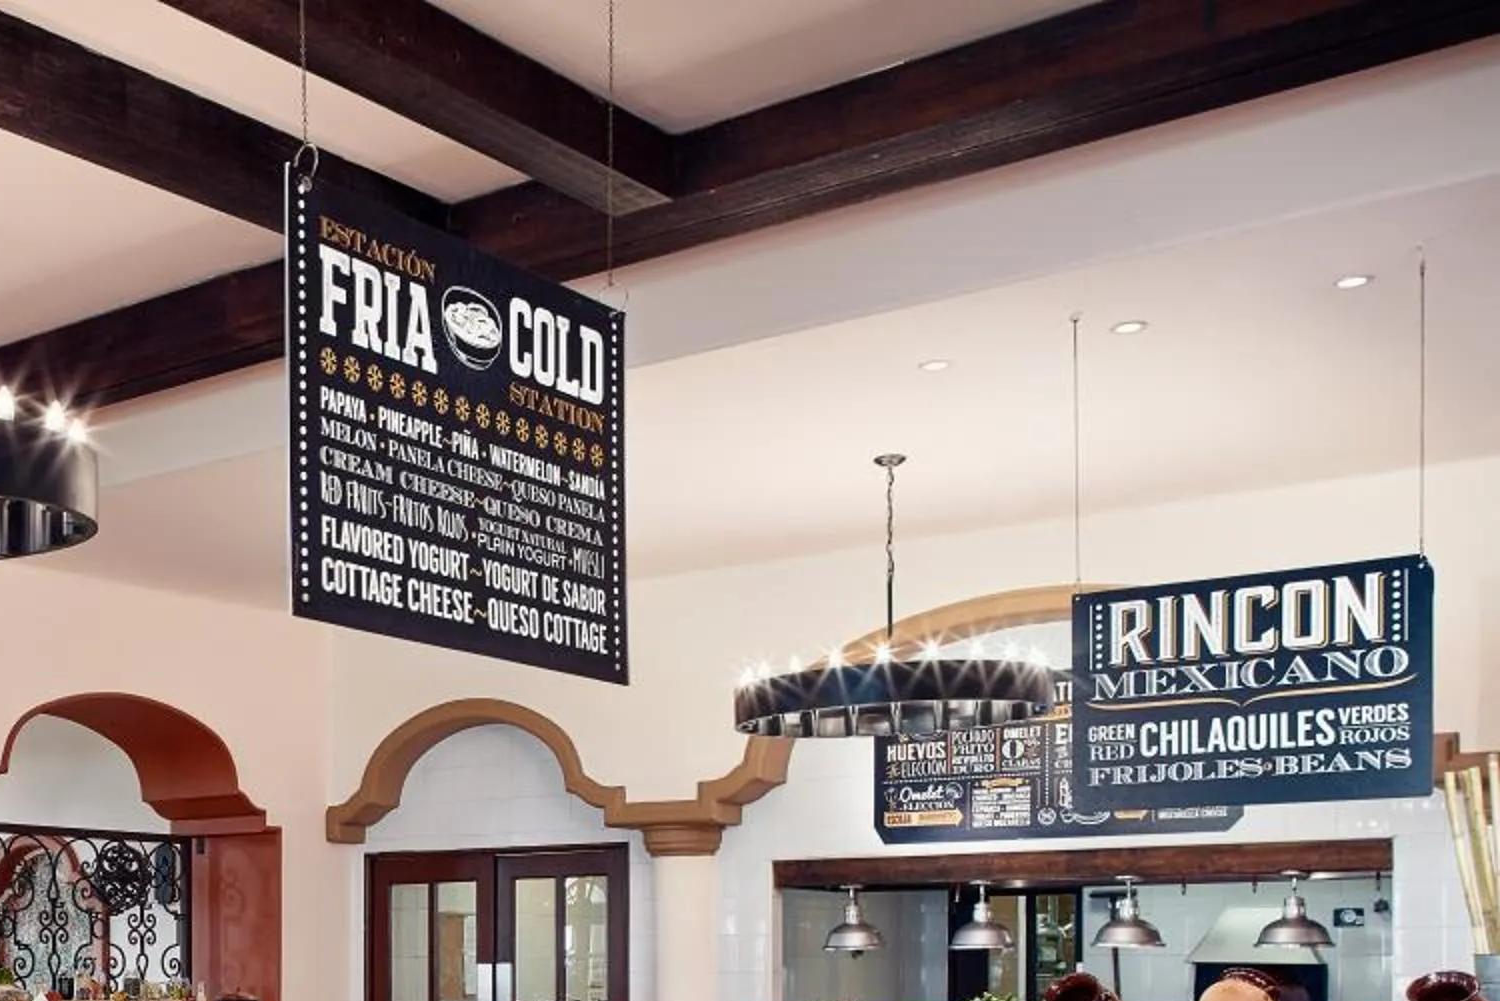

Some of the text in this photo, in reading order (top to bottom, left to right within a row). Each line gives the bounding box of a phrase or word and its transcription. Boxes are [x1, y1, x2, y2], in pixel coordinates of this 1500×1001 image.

[318, 214, 436, 285] ESTACIÓN
[318, 243, 605, 406] FRIA COLD
[320, 385, 367, 423] PAPAYA
[378, 406, 443, 449] PINEAPPLE
[452, 429, 479, 461] PIÑA
[489, 443, 561, 486] WATERMELON
[507, 382, 605, 433] STATION
[320, 415, 605, 522] MELON PANELA CHEESE QUESO PANELA
[320, 446, 604, 546] CREAM CHEESE QUESO CREMA
[477, 533, 515, 557] PLAIN
[518, 544, 567, 570] YOGURT
[478, 517, 521, 541] YOGURT
[321, 514, 606, 616] FLAVORED YOGURT YOGURT DE SABOR
[321, 556, 608, 655] COTTAGE CHEESE QUESO COTTAGE
[1108, 571, 1387, 668] RINCON
[1091, 646, 1410, 701] MEXICANO
[887, 741, 947, 762] HUEVOS
[1088, 723, 1136, 743] GREEN
[1140, 708, 1336, 758] CHILAQUILES
[1337, 702, 1410, 725] VERDES
[1089, 743, 1136, 761] RED
[1338, 726, 1411, 745] ROJOS
[1087, 757, 1263, 787] FRIJOLES
[1271, 747, 1412, 777] BEANS
